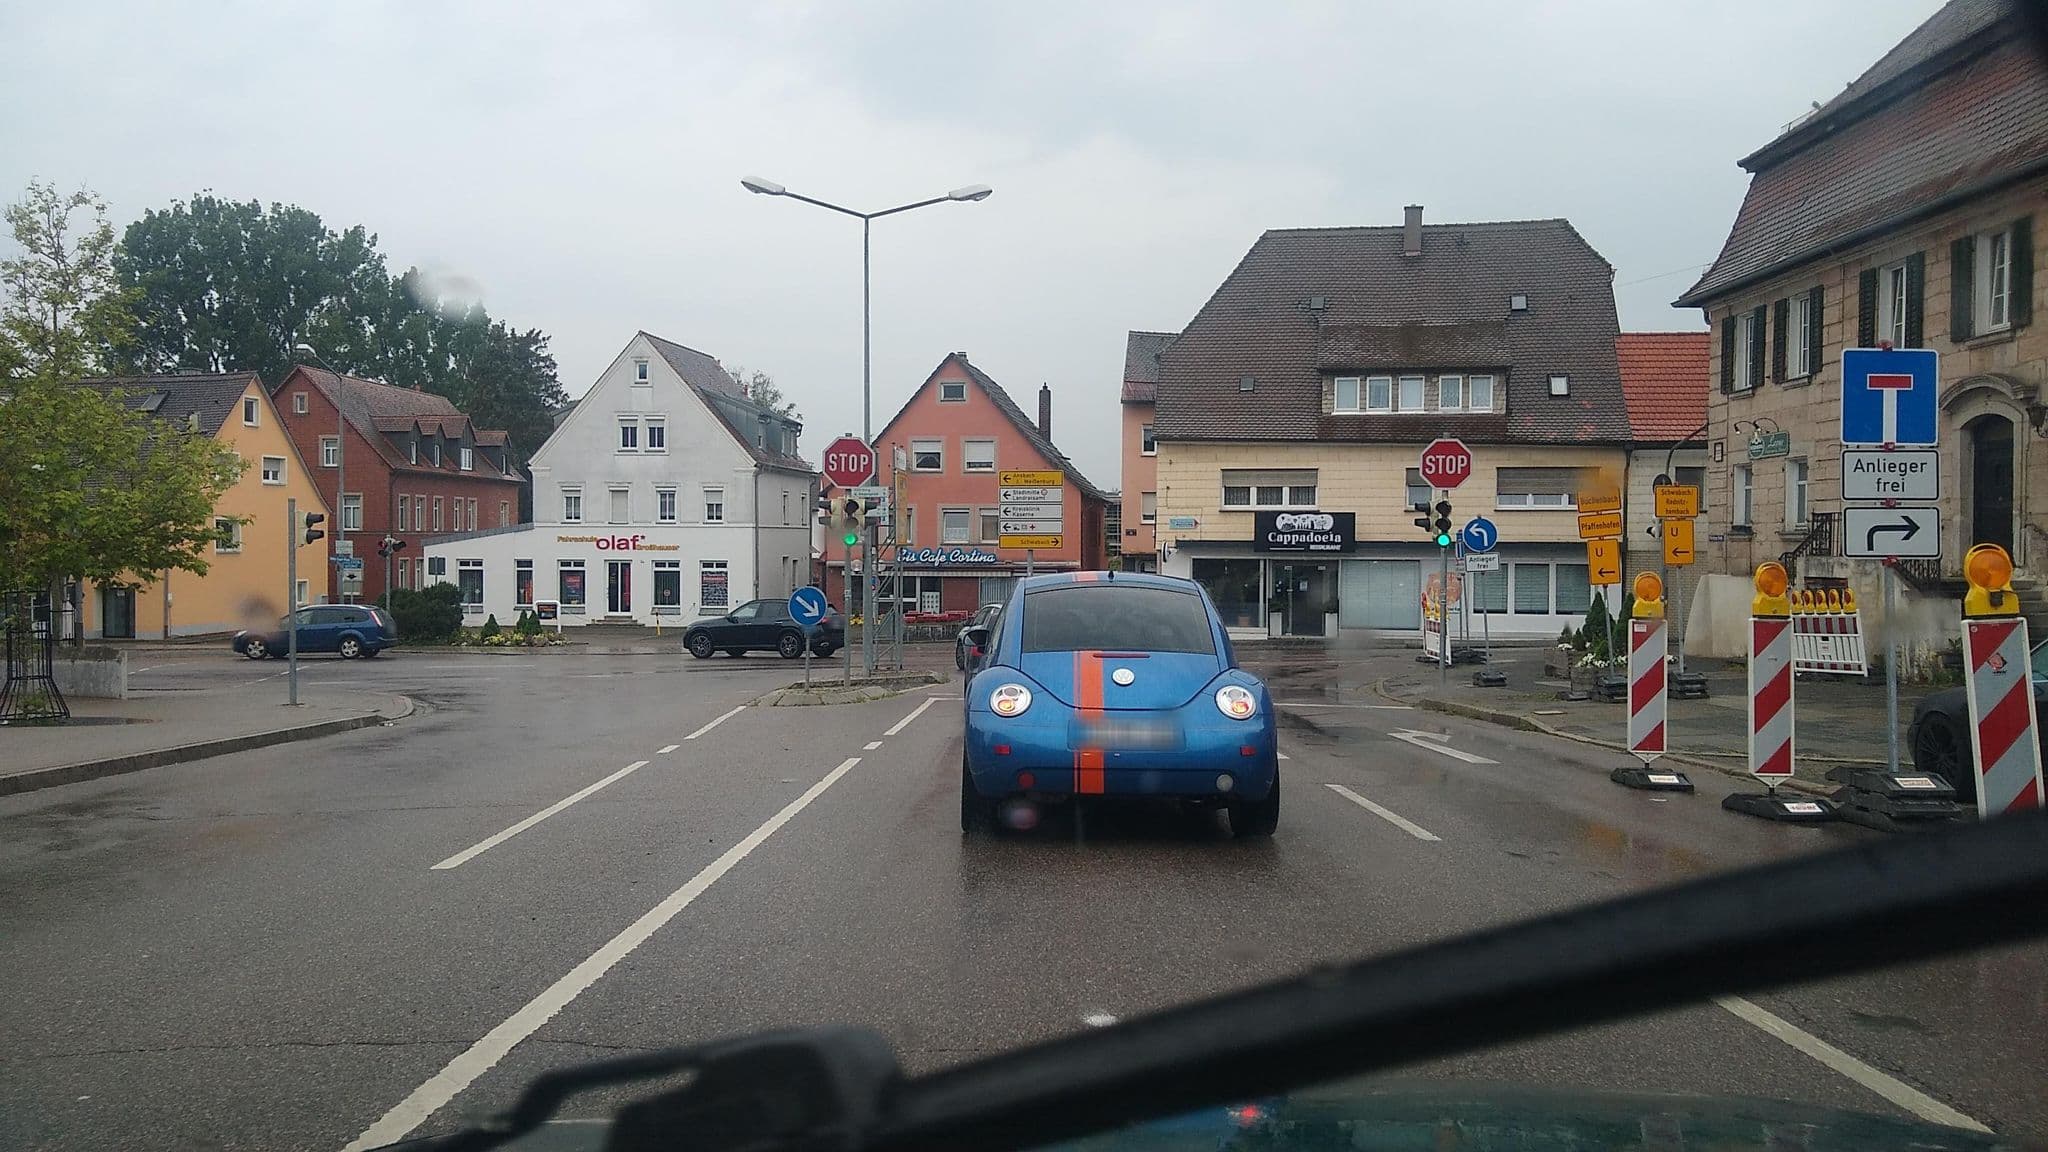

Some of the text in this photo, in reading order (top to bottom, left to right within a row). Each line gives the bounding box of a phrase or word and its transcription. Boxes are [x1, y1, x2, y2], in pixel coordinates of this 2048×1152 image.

[828, 453, 869, 473] STOP
[1425, 455, 1467, 475] STOP
[1853, 458, 1928, 476] Anlieger
[1876, 477, 1905, 492] frei
[1581, 520, 1620, 531] Pfaffenhofen
[1671, 527, 1679, 537] U
[919, 548, 947, 566] Cafe
[949, 548, 996, 562] Cortina
[1595, 548, 1603, 558] U
